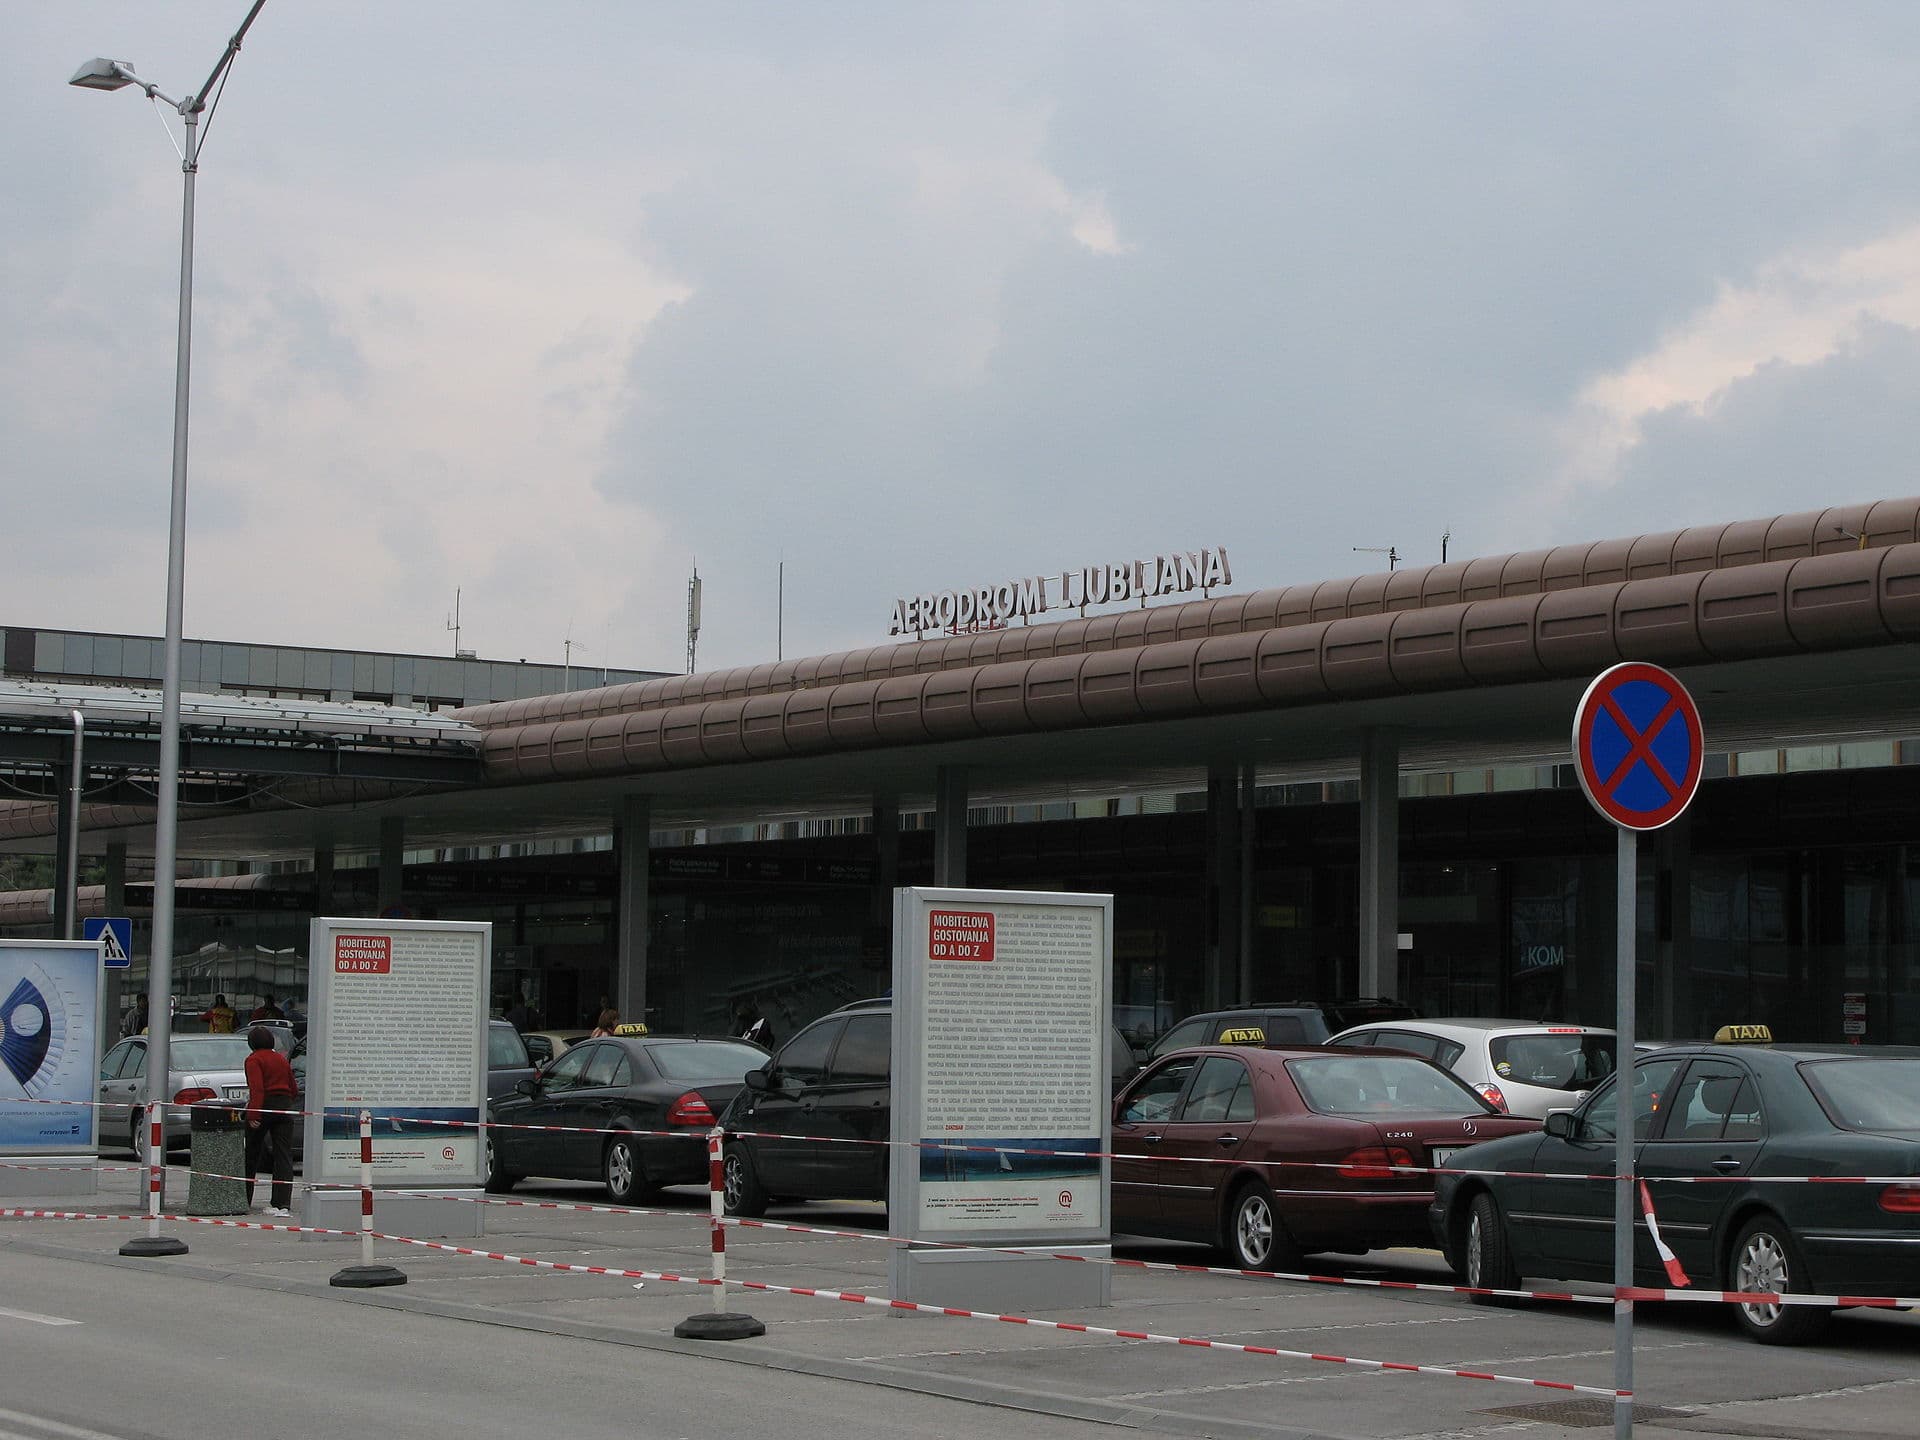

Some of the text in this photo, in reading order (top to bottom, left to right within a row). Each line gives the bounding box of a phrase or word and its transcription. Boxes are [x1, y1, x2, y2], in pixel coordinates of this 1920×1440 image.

[888, 546, 1233, 636] AERODROM LJUBLJANA
[933, 914, 989, 929] MOBITELOVA
[933, 929, 989, 943] GOSTOVANJA
[338, 938, 386, 949] MOBITELOVA
[338, 949, 386, 960] GOSTOVANJA
[933, 944, 980, 957] OD A DO Z
[338, 961, 378, 971] OD A DO Z
[622, 1023, 645, 1033] TAXI
[1729, 1025, 1767, 1039] TAXI
[1231, 1030, 1261, 1041] TAXI
